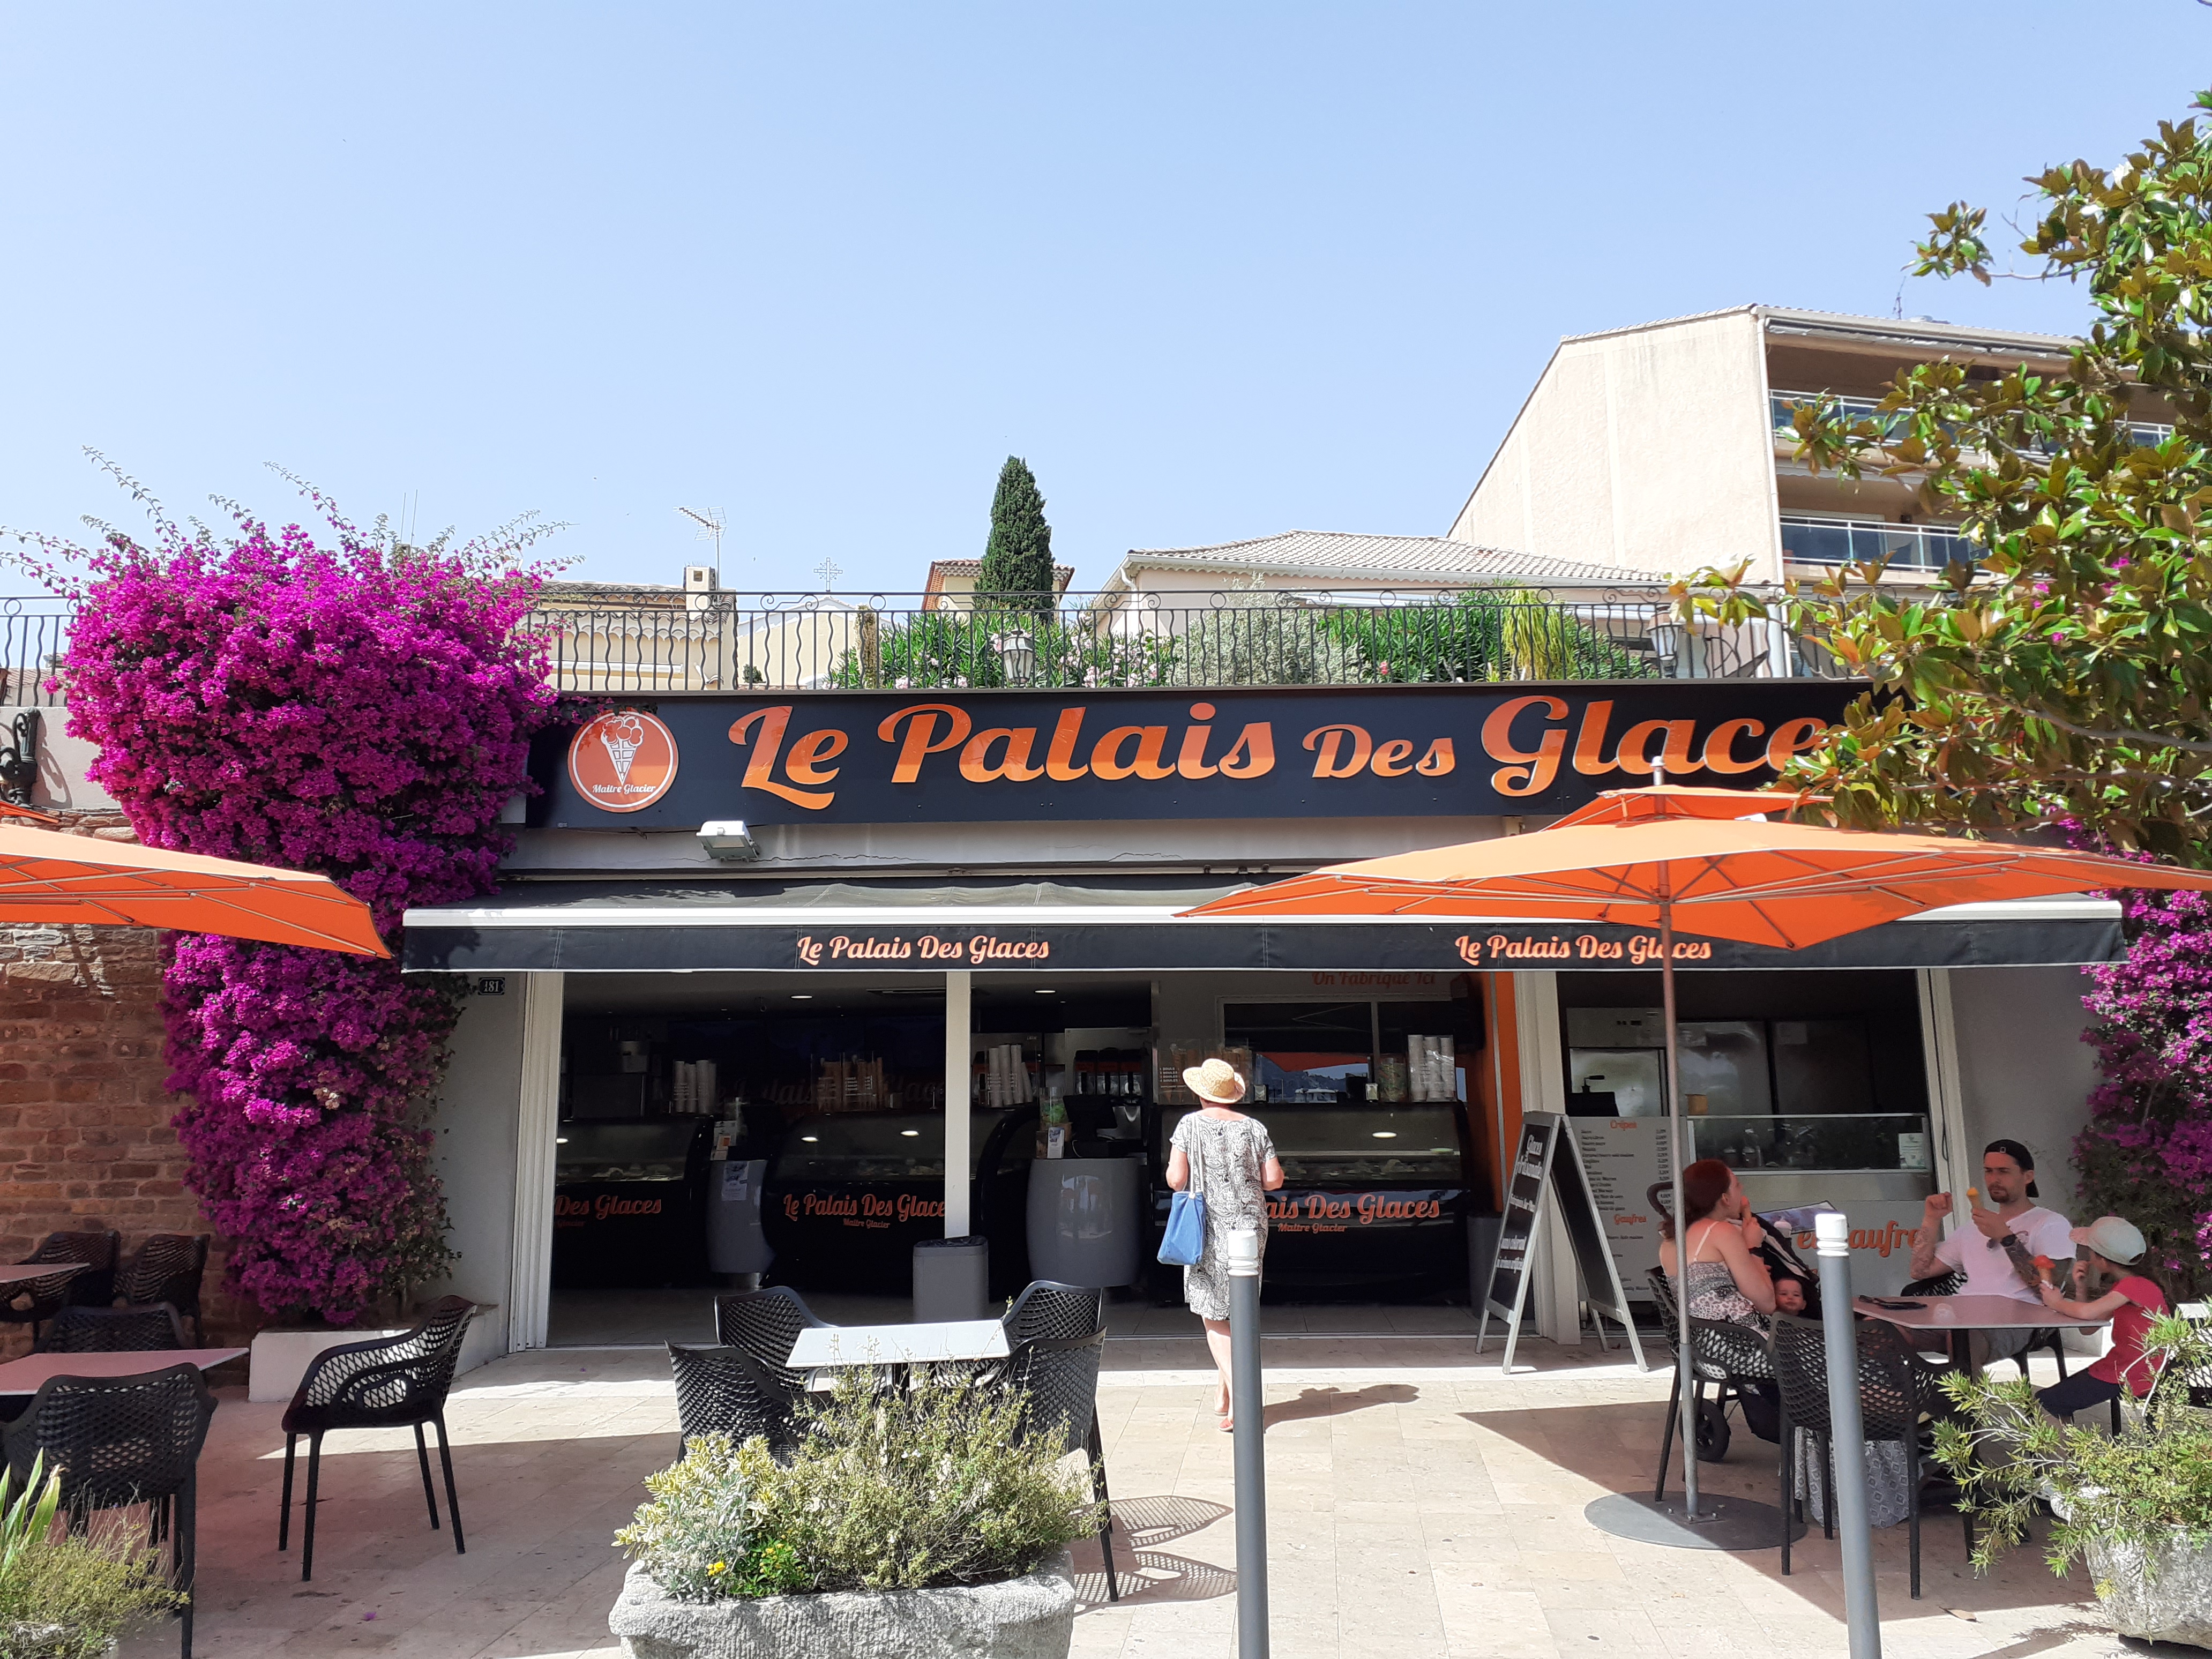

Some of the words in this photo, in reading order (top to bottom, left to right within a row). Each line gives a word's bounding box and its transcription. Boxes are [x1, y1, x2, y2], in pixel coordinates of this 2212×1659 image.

[728, 705, 849, 810] Le
[877, 702, 1276, 783] Palais
[1302, 723, 1456, 779] Des
[1481, 695, 1828, 797] Glace
[624, 784, 655, 795] Glacier
[797, 936, 823, 966] Le
[829, 936, 911, 959] Palais
[917, 935, 962, 959] Des
[968, 935, 1049, 964] Glaces
[1455, 935, 1481, 966] Le
[1486, 935, 1571, 958] Palais
[1574, 935, 1623, 958] Des
[1338, 972, 1415, 989] Fabrique
[594, 1194, 662, 1220] Glaces
[783, 1193, 800, 1222] Le
[803, 1193, 857, 1216] Palais
[861, 1193, 893, 1216] Des
[1304, 1194, 1350, 1219] Des
[1356, 1194, 1440, 1225] Glaces
[1312, 1222, 1348, 1234] Glacier
